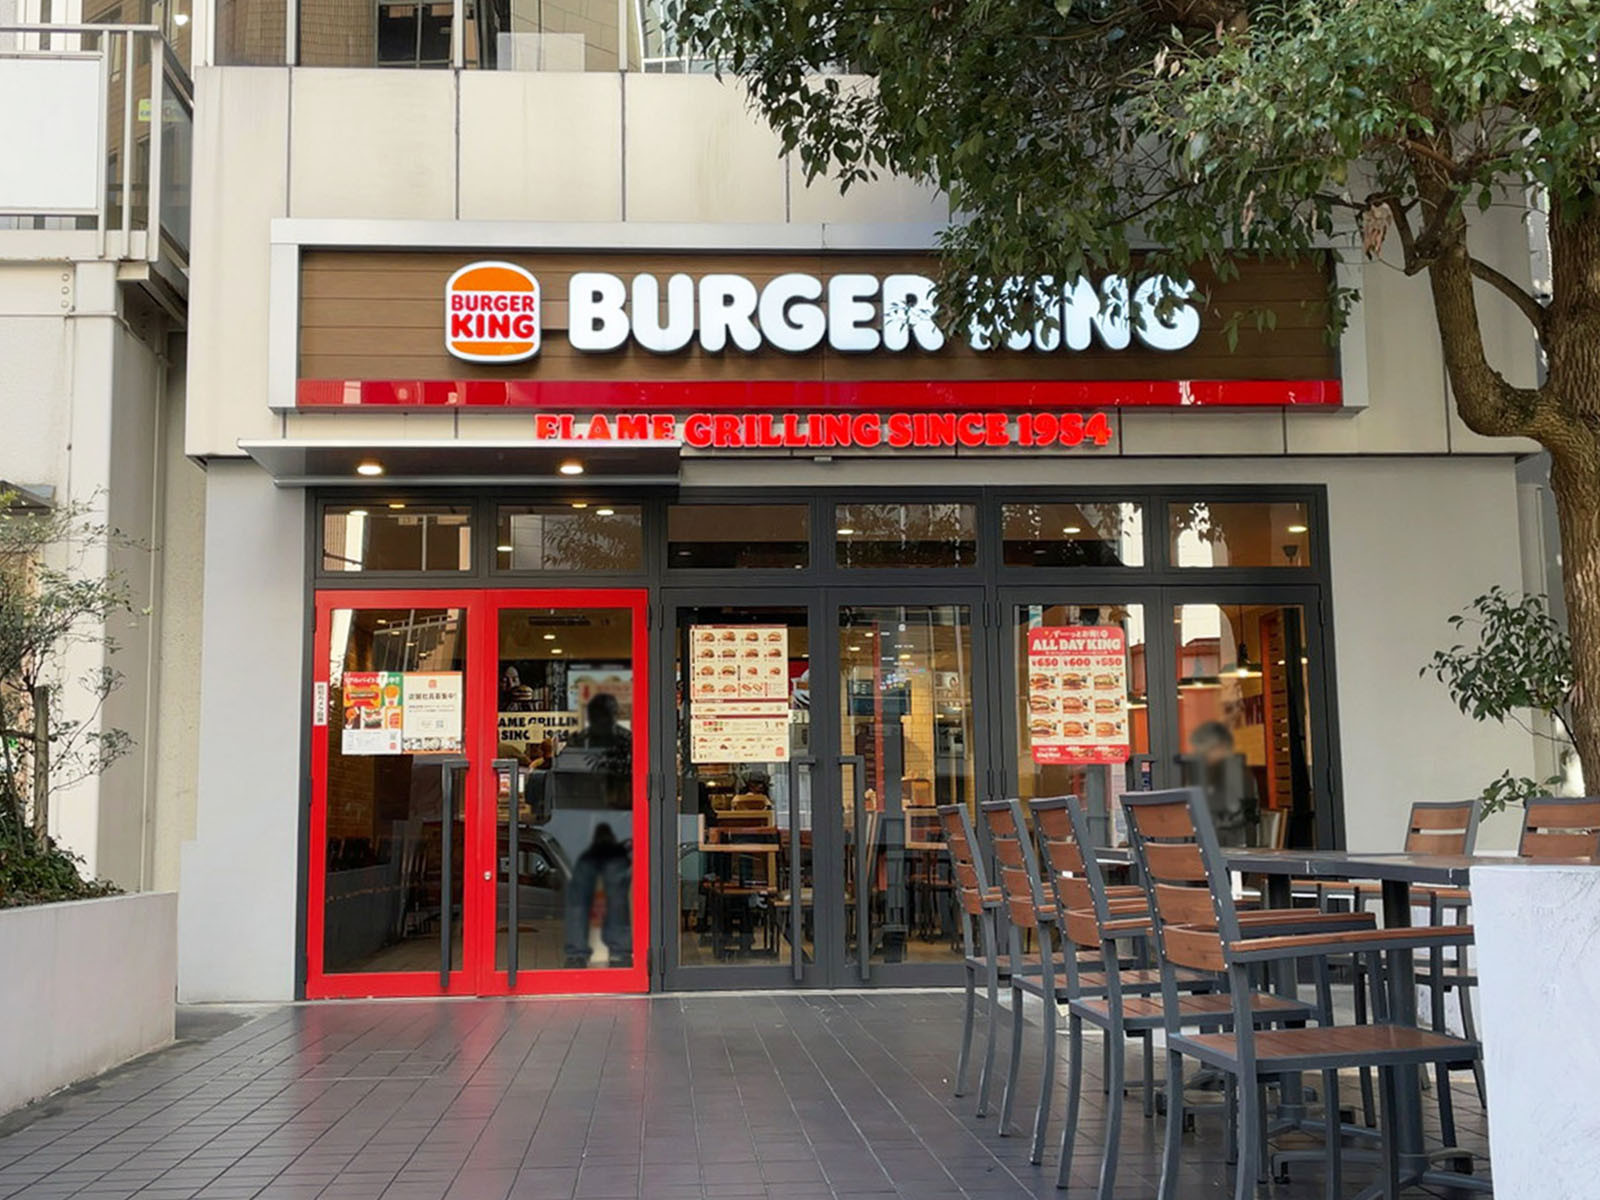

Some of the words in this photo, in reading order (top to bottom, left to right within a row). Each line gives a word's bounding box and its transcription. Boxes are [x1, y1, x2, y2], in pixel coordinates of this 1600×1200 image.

[451, 294, 535, 312] BURGER
[568, 272, 944, 351] BURGER
[451, 313, 535, 339] KING
[535, 413, 676, 440] FLAME
[683, 413, 882, 447] GRILLING
[887, 412, 1010, 447] SINCE
[1017, 412, 1113, 446] 1954
[1033, 639, 1059, 651] ALL
[1060, 639, 1086, 651] DAY
[1087, 639, 1121, 651] KING
[501, 730, 531, 740] SINC
